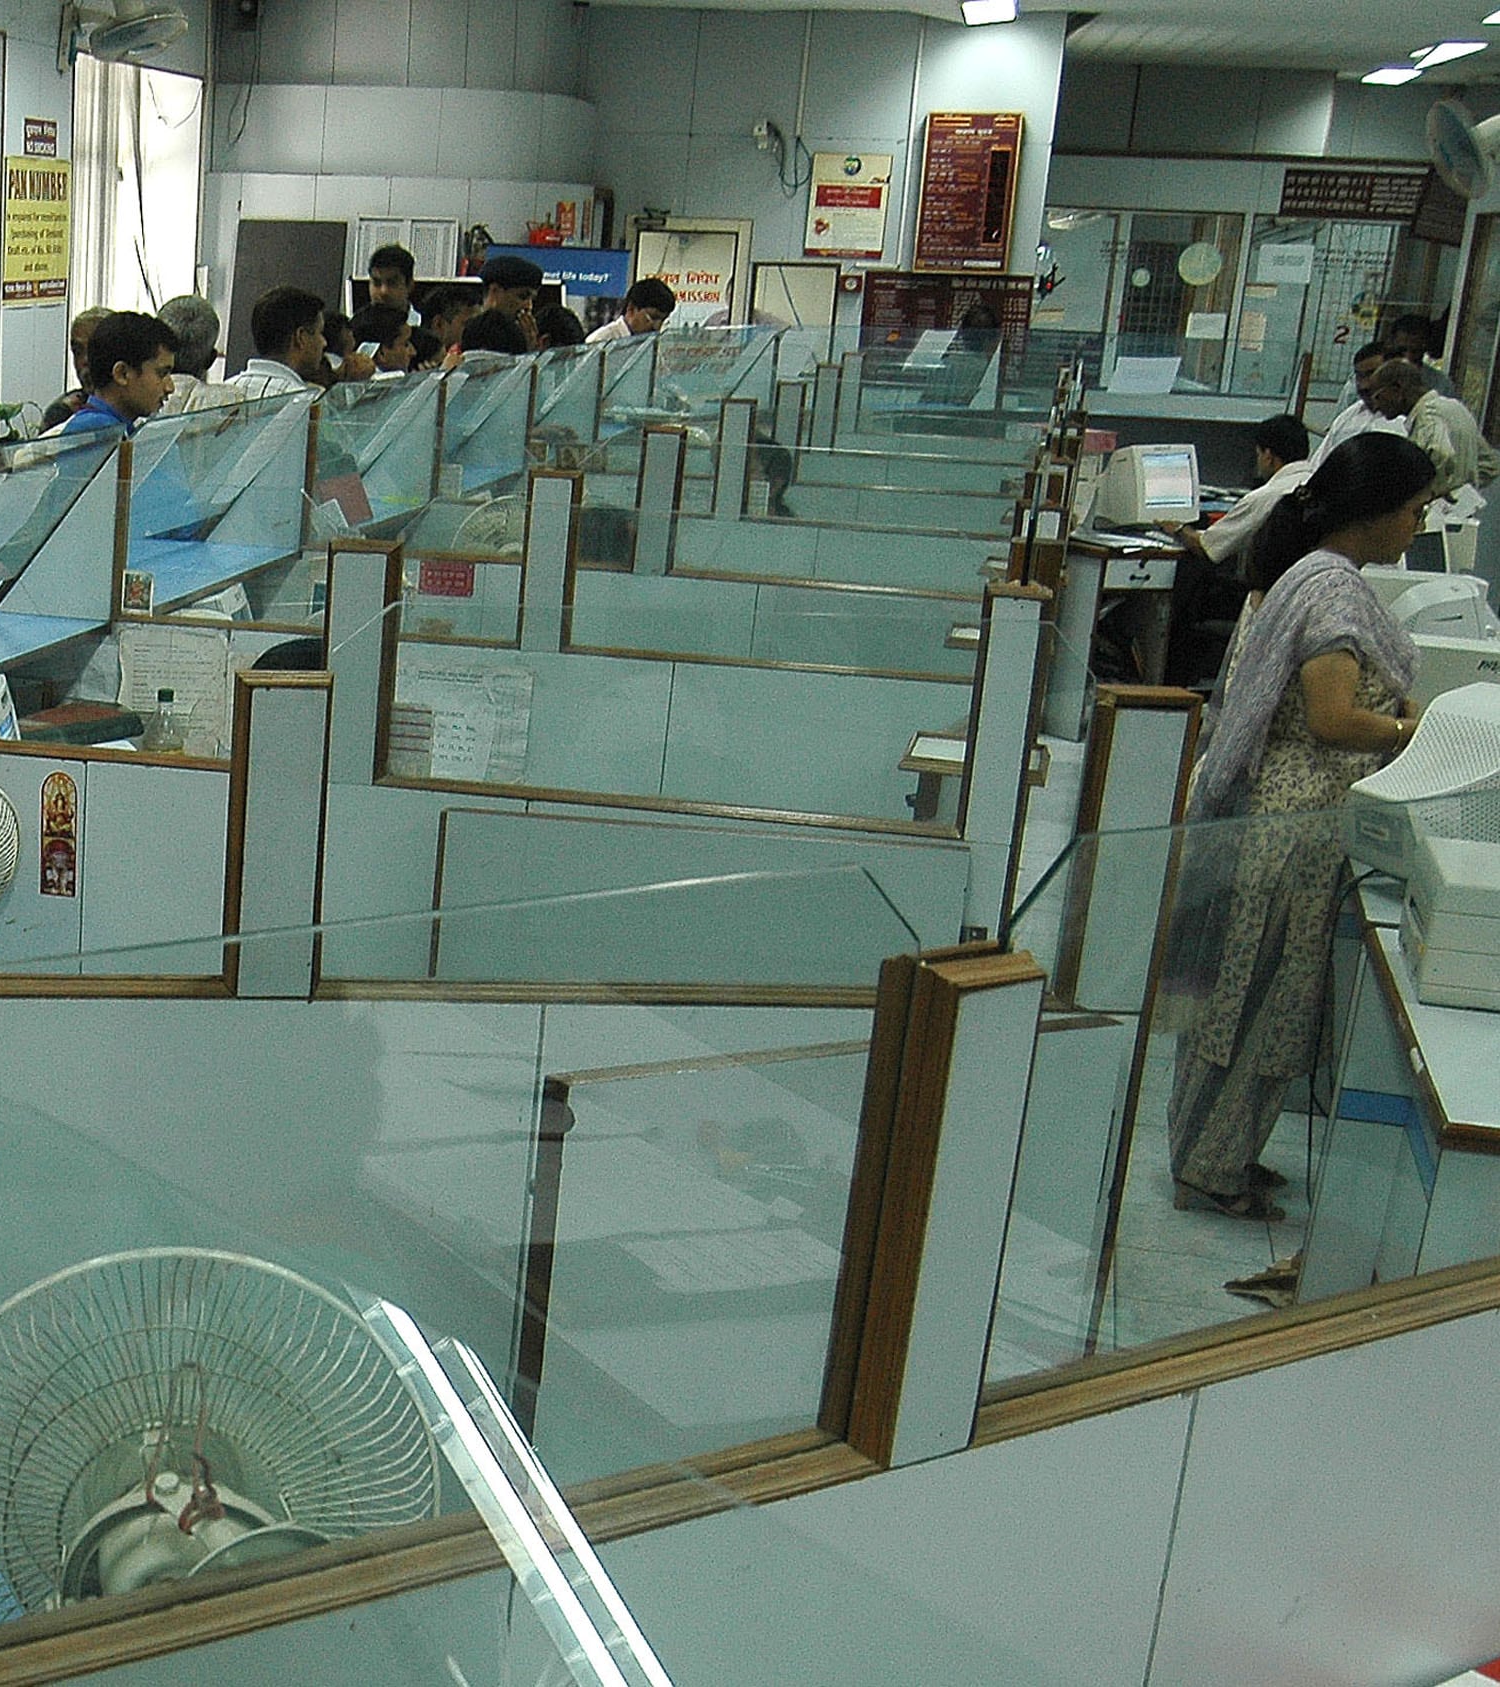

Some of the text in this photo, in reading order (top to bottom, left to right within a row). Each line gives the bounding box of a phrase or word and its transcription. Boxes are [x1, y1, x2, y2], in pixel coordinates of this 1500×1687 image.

[8, 169, 67, 201] PAN NUMBER
[562, 270, 576, 280] life
[578, 272, 609, 283] today?
[1334, 325, 1349, 344] 2
